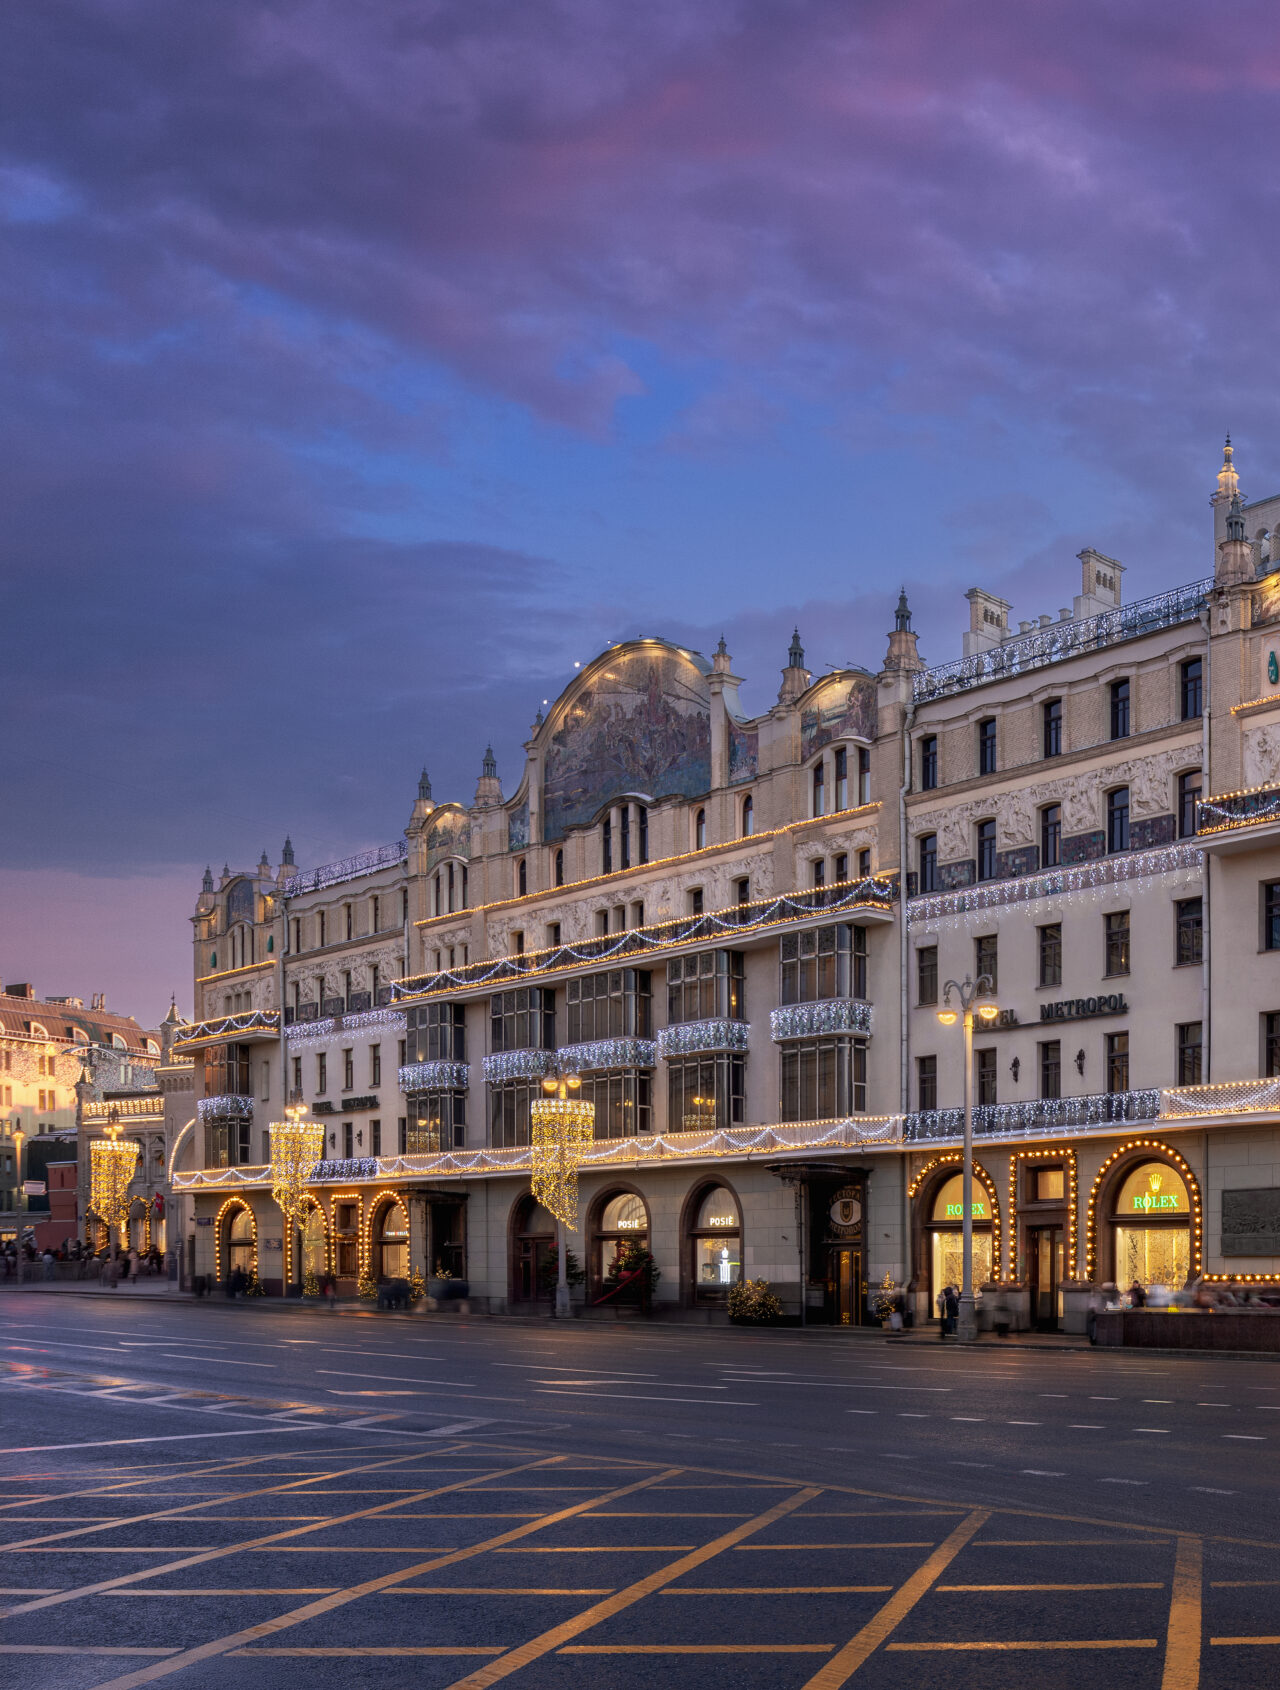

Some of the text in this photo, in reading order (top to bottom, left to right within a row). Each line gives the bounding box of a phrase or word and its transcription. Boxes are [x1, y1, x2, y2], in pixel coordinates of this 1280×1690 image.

[1040, 993, 1128, 1020] METROPOL
[1133, 1195, 1179, 1209] ROLEX
[946, 1203, 985, 1216] ROEX
[709, 1216, 734, 1226] POSIÈ
